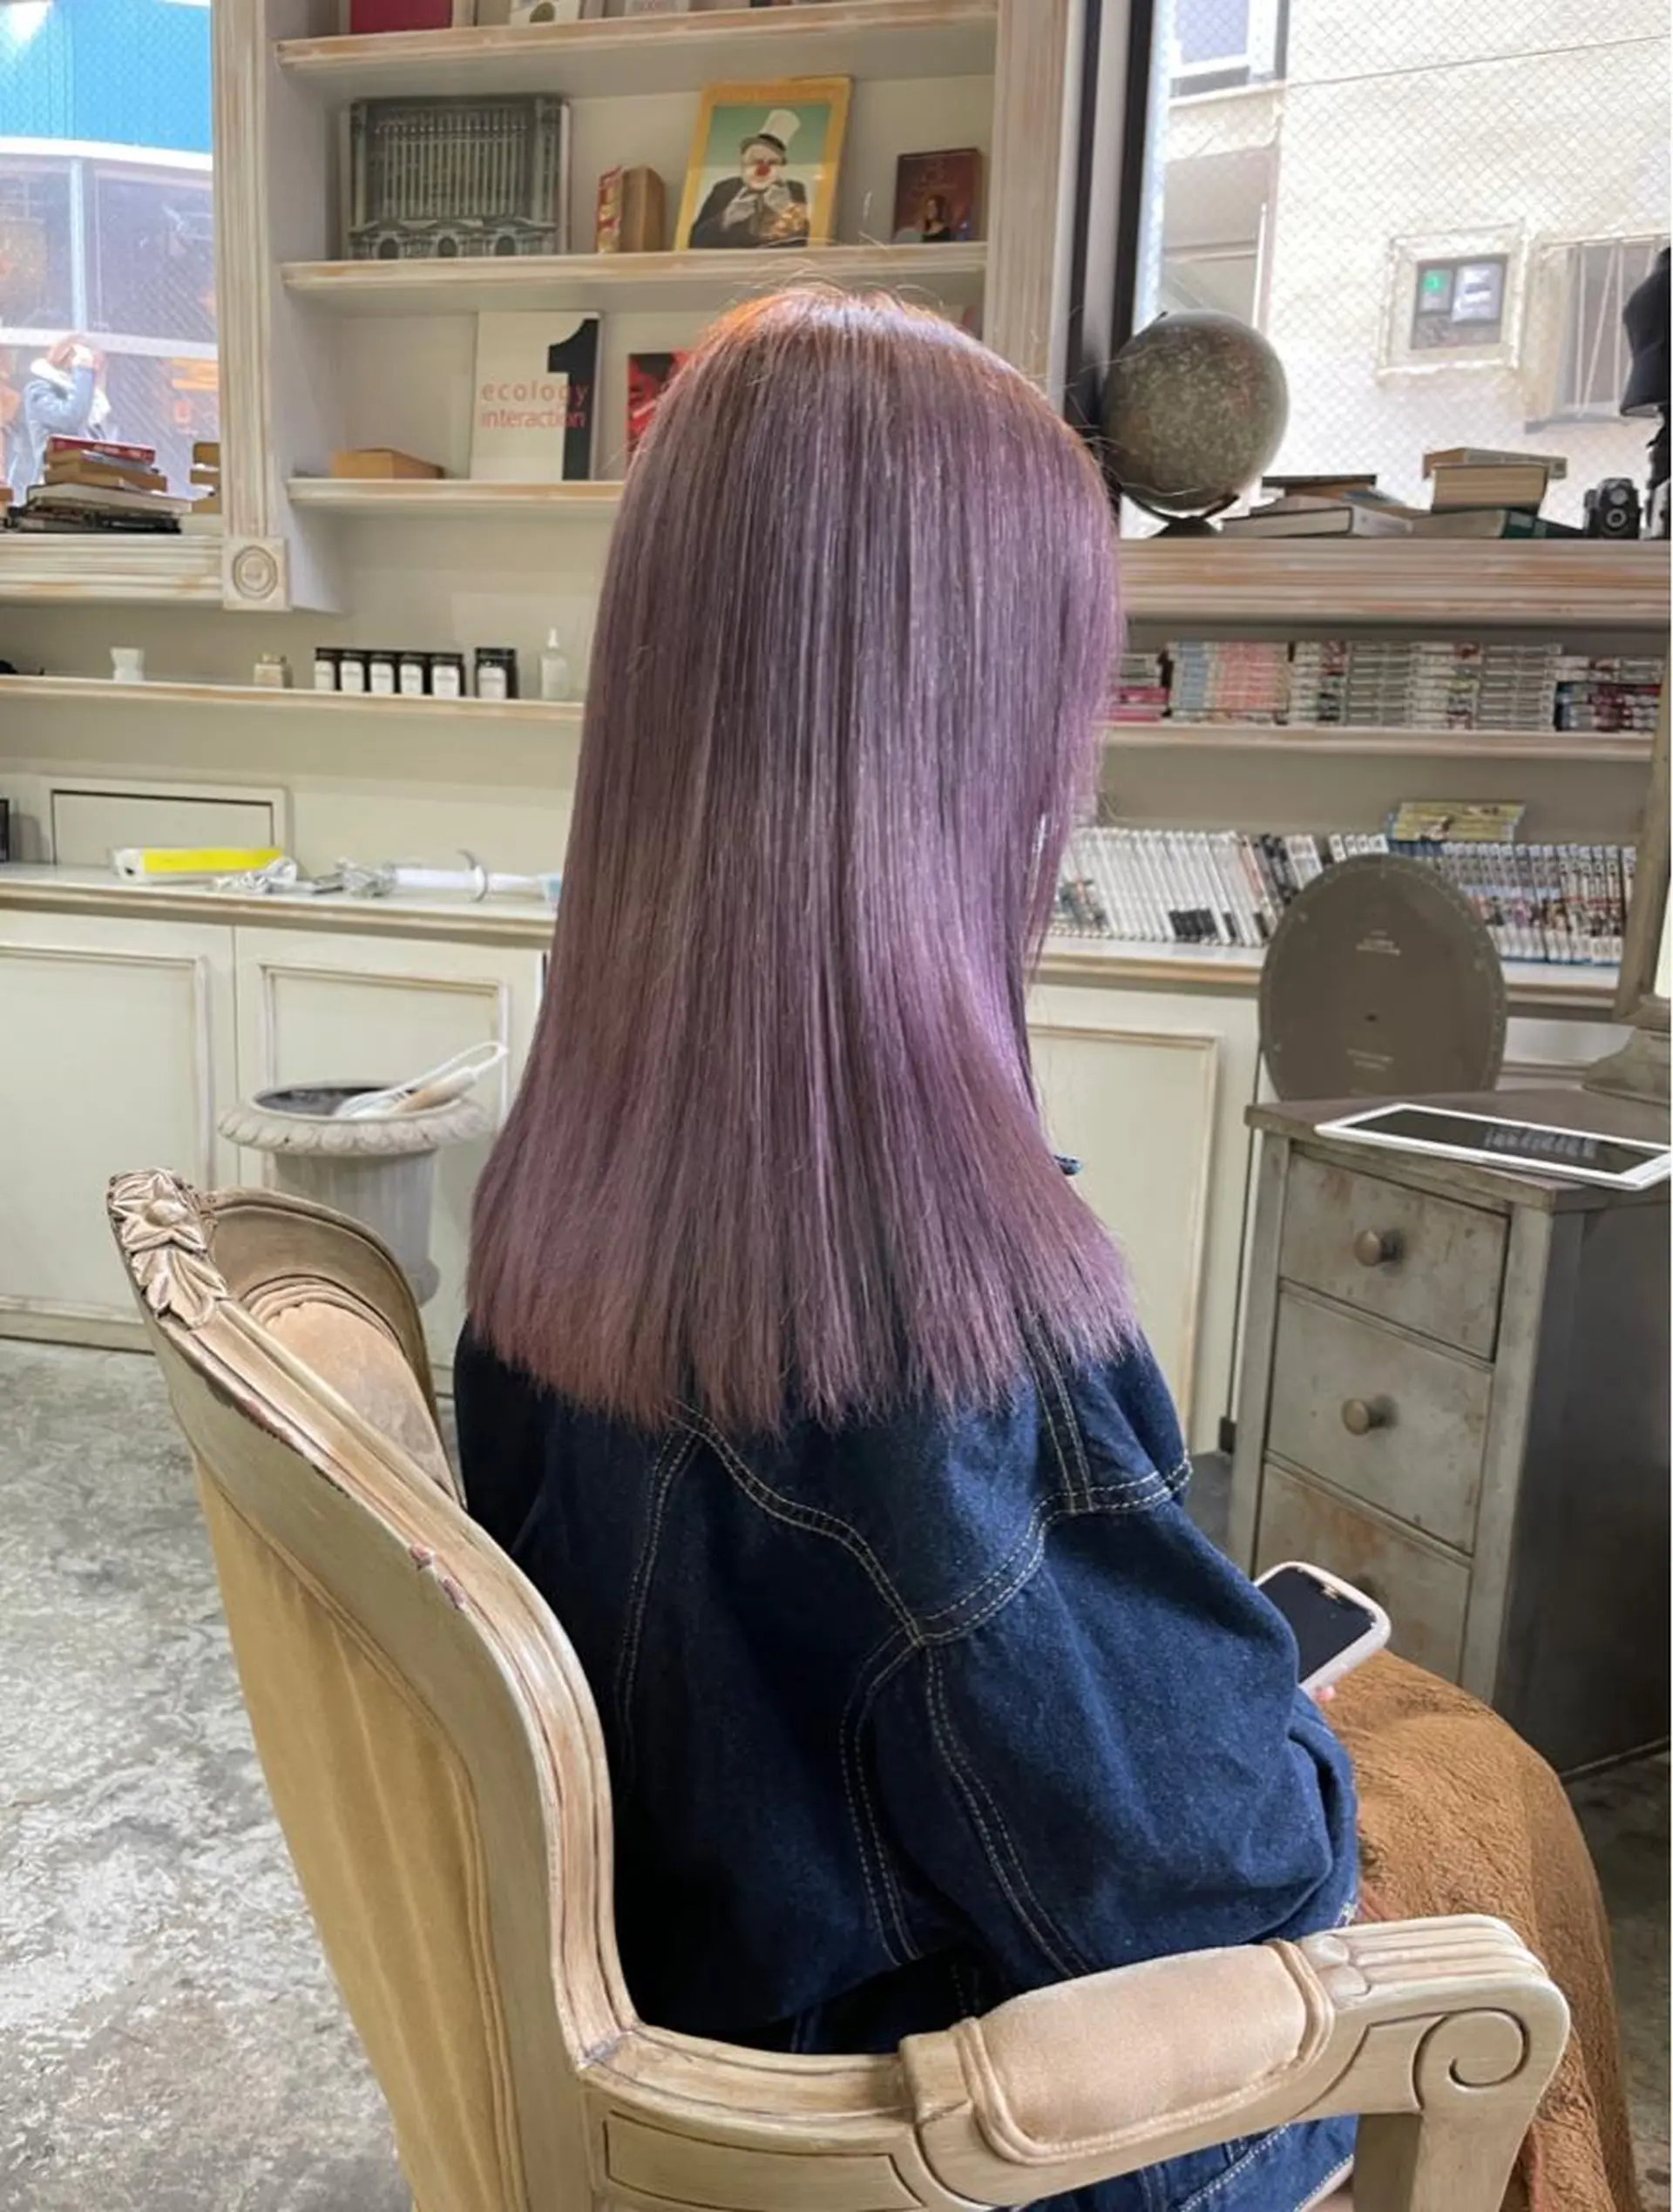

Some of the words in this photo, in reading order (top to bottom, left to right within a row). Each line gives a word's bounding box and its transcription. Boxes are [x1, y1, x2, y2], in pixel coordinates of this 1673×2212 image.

[482, 380, 589, 409] ecology
[547, 318, 599, 480] 1
[481, 409, 585, 429] interaction
